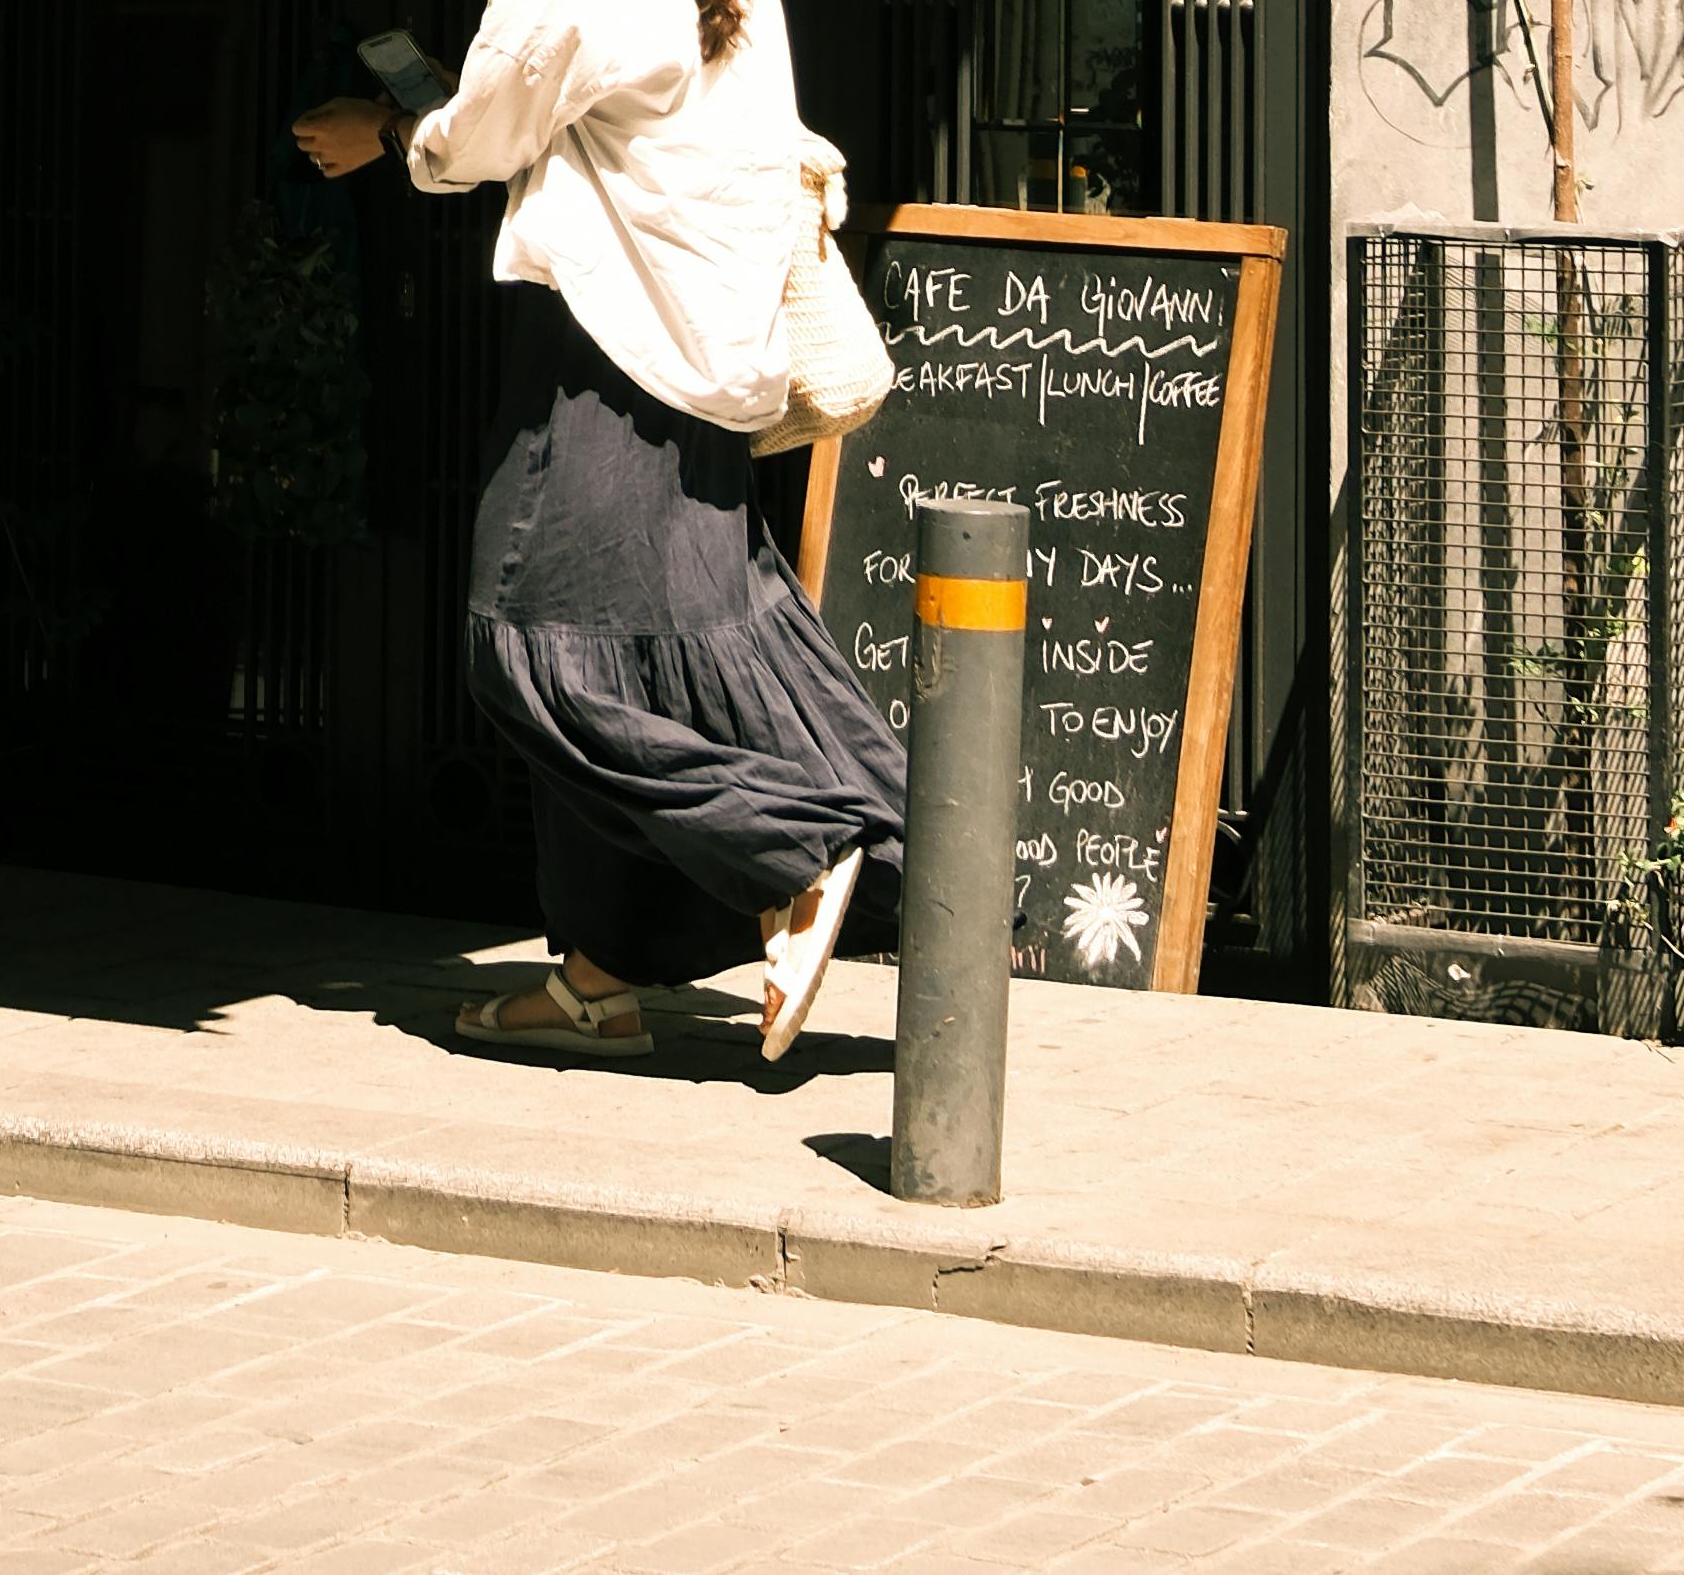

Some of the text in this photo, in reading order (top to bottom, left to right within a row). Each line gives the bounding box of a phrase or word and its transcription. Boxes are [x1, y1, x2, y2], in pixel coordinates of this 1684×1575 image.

[884, 261, 972, 322] CAFE
[997, 270, 1052, 325] DA
[891, 361, 1221, 408] EAKFAST LUNCH COFFEE
[863, 549, 916, 585] FOR
[1048, 770, 1125, 817] GOOD
[1015, 827, 1163, 883] OOD PEOPLE
